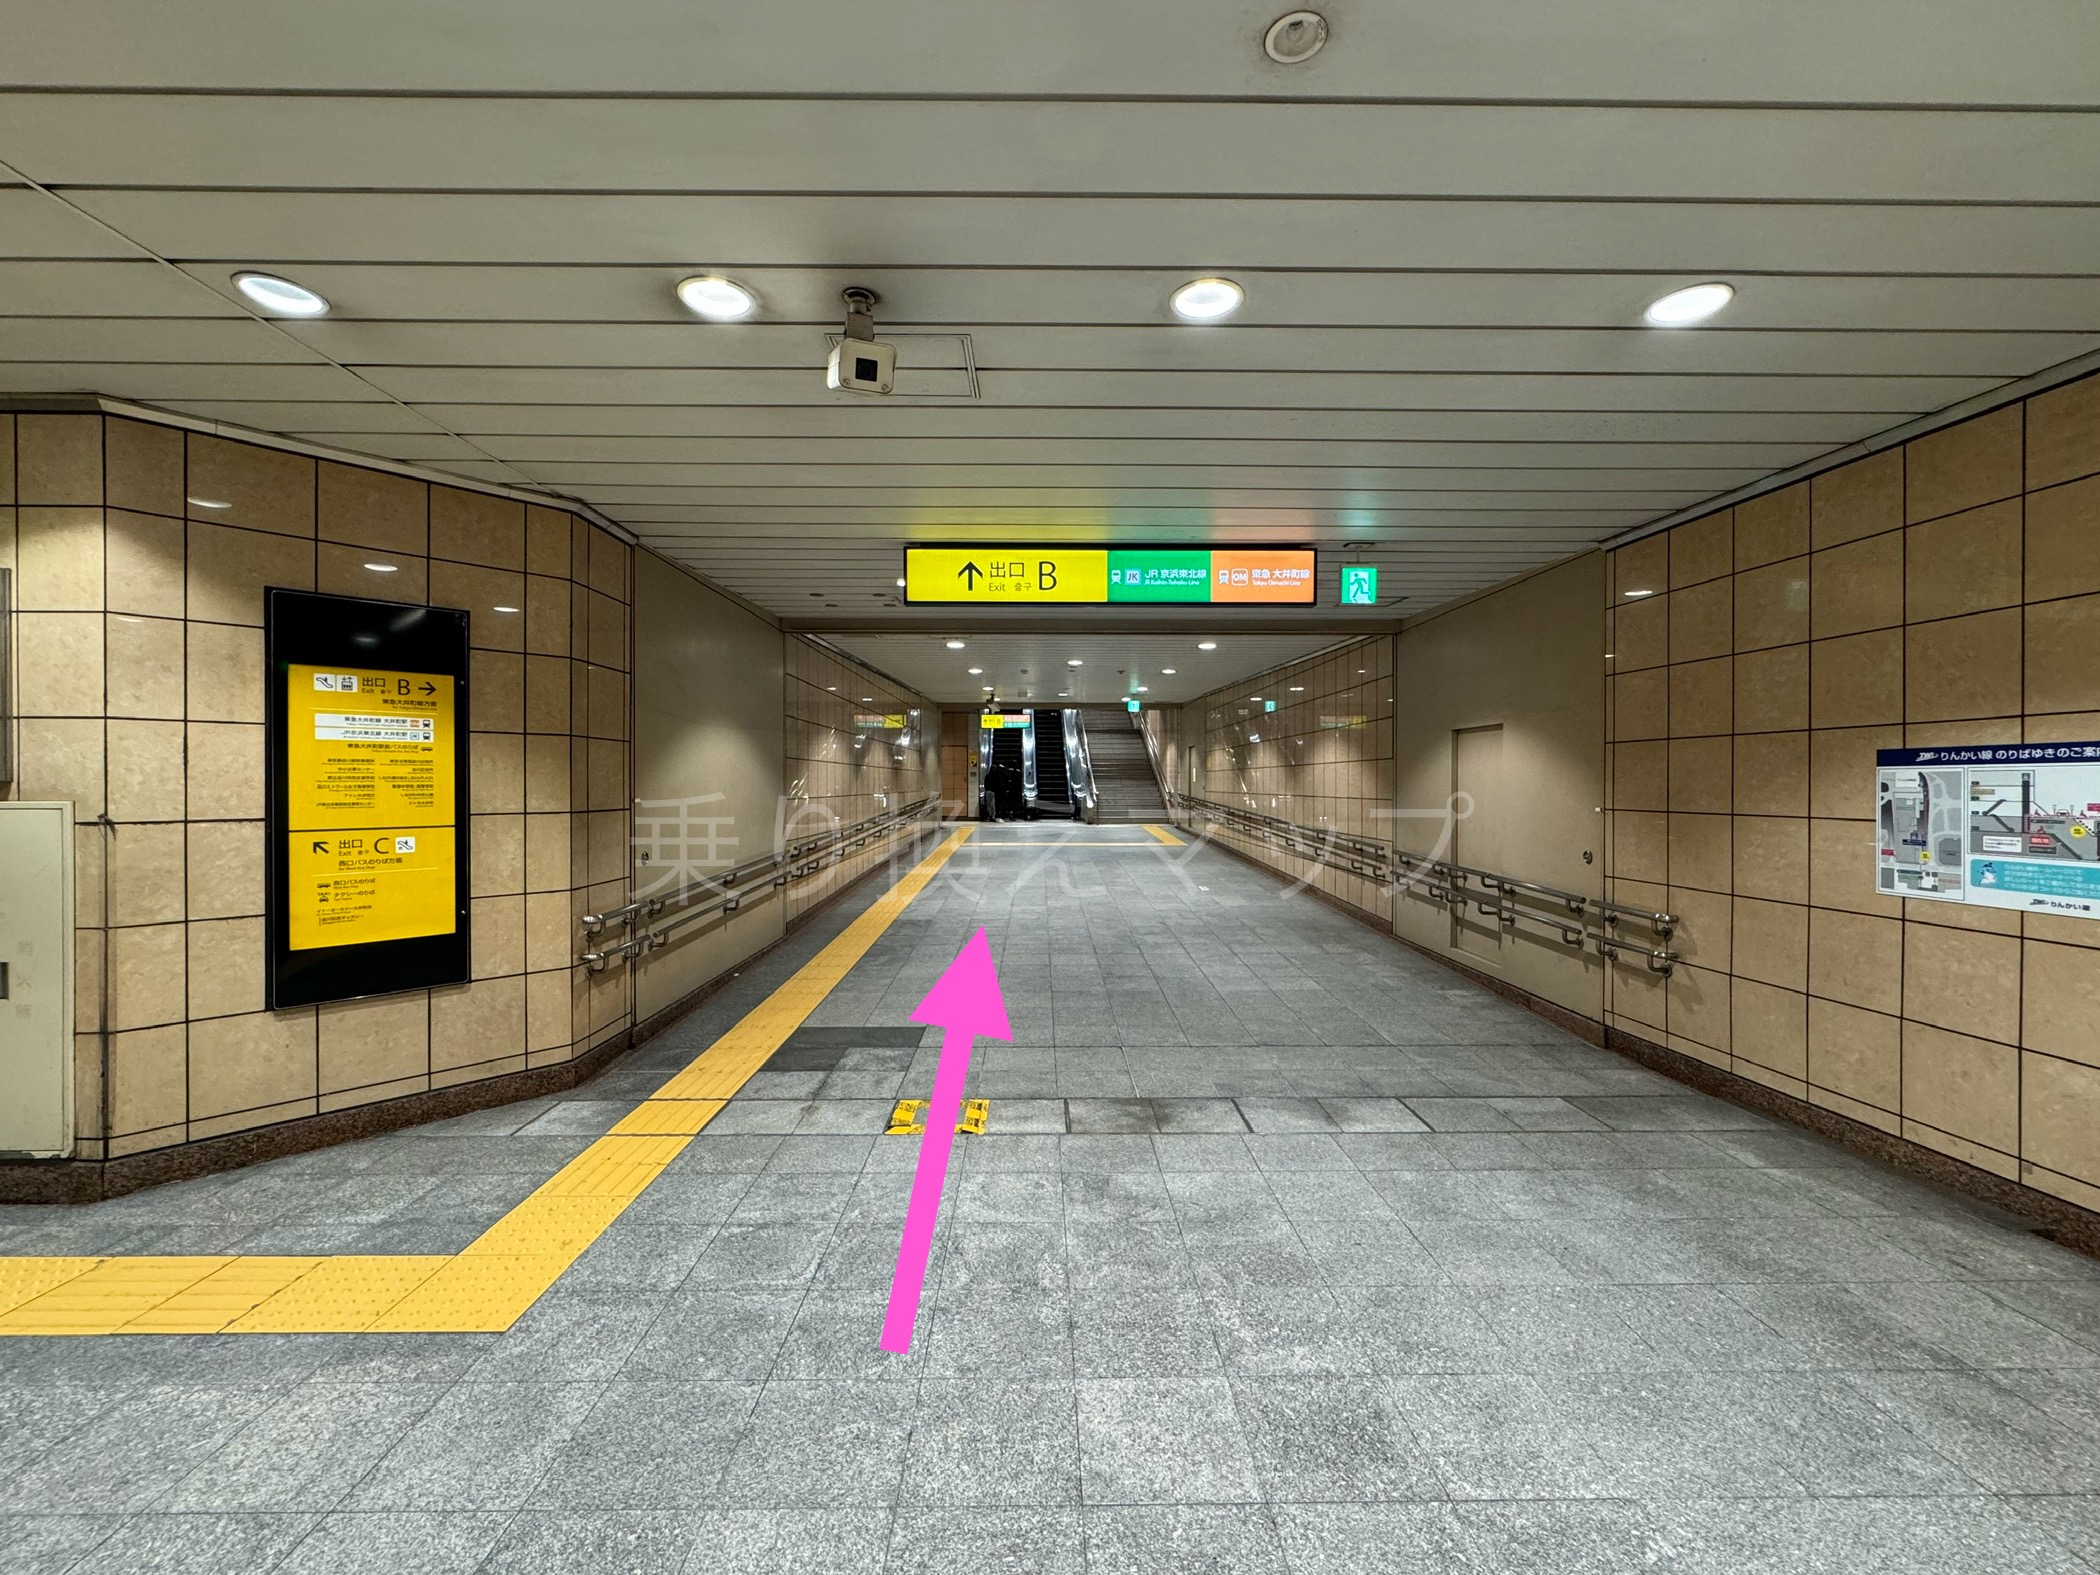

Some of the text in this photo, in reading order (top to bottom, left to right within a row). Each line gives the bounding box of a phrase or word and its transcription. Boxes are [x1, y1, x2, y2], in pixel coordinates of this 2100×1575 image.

[989, 560, 1058, 591] 出口 B
[1127, 572, 1138, 582] JK
[1144, 568, 1207, 579] JR 京浜東北線
[1233, 573, 1247, 582] OM
[1252, 568, 1310, 579] 東急 大井町線
[989, 582, 1006, 592] Exit
[362, 677, 411, 696] 出口 B
[1940, 749, 1993, 761] りんかい線
[338, 837, 390, 855] 出口 C
[338, 857, 403, 867] 西口バスのりば方面
[2050, 901, 2091, 911] りんかい線
